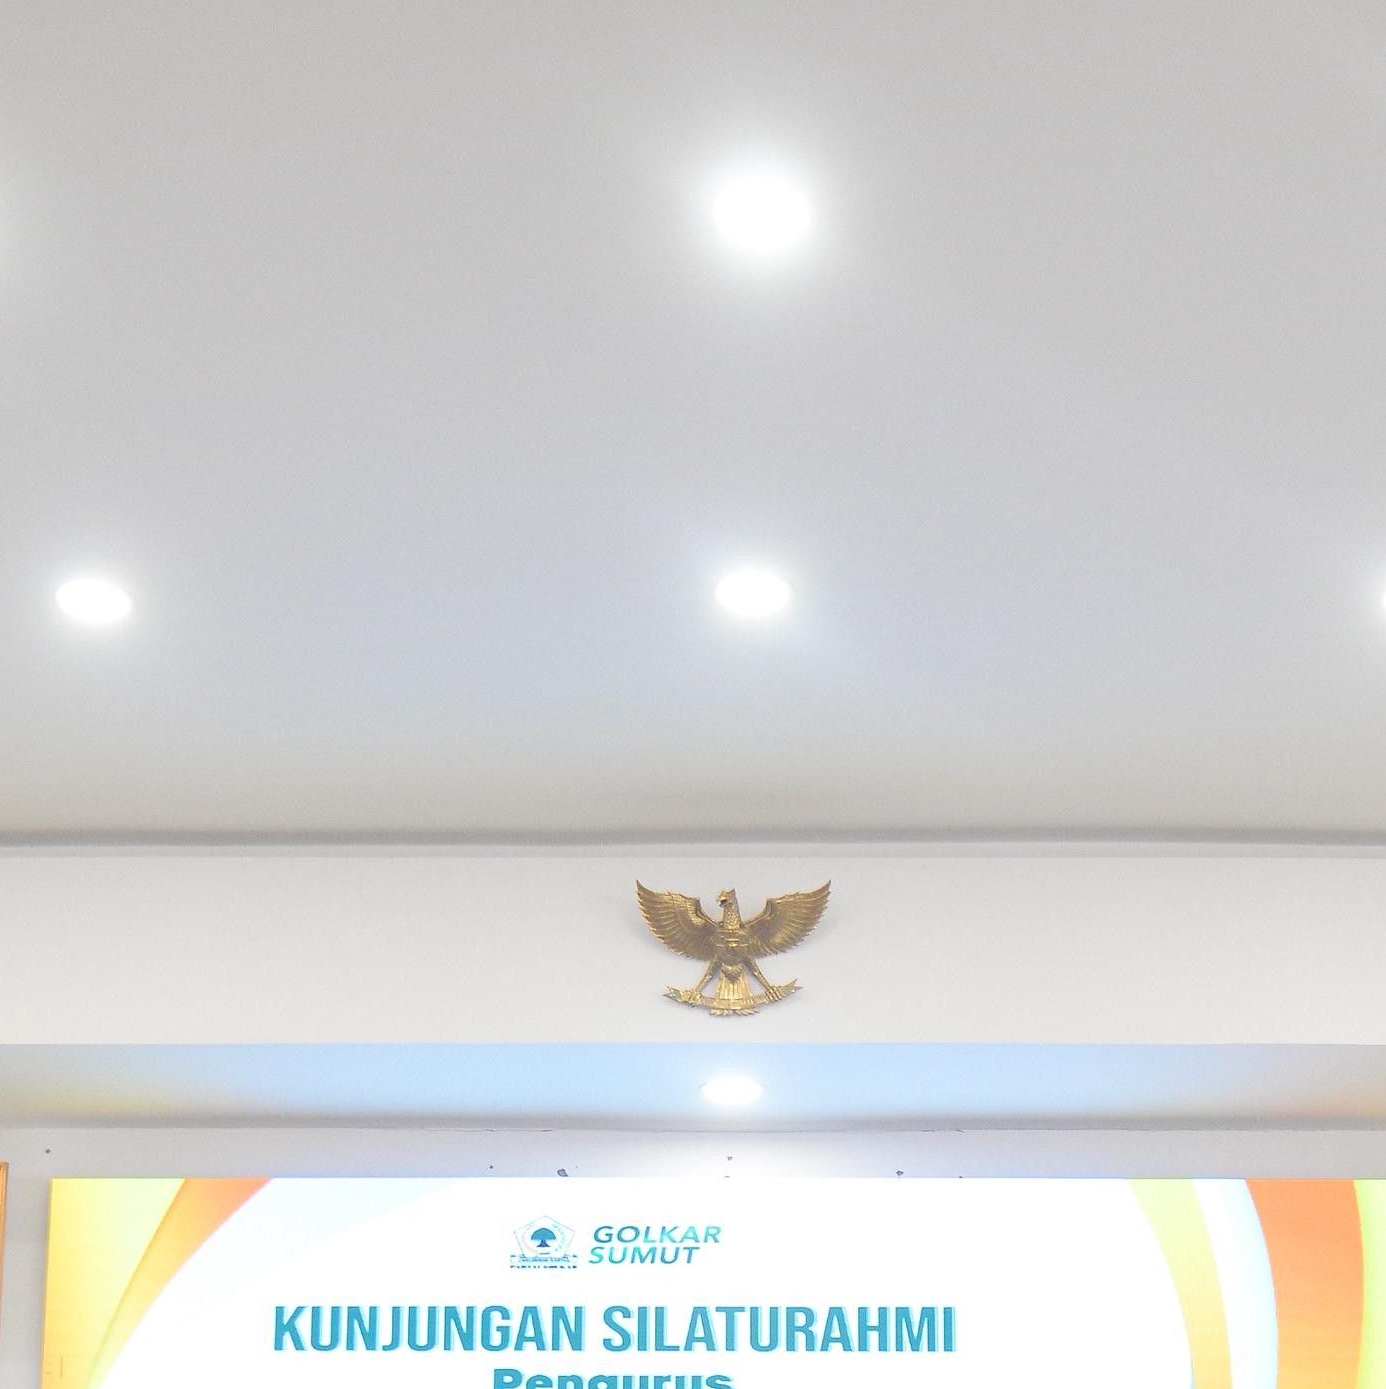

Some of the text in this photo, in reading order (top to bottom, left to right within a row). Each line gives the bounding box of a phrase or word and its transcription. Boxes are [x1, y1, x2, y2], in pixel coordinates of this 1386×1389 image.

[593, 1225, 722, 1243] GOLKAR
[588, 1246, 700, 1264] SUMUT
[274, 1305, 957, 1352] KUNJUNGAN SILATURAHMI
